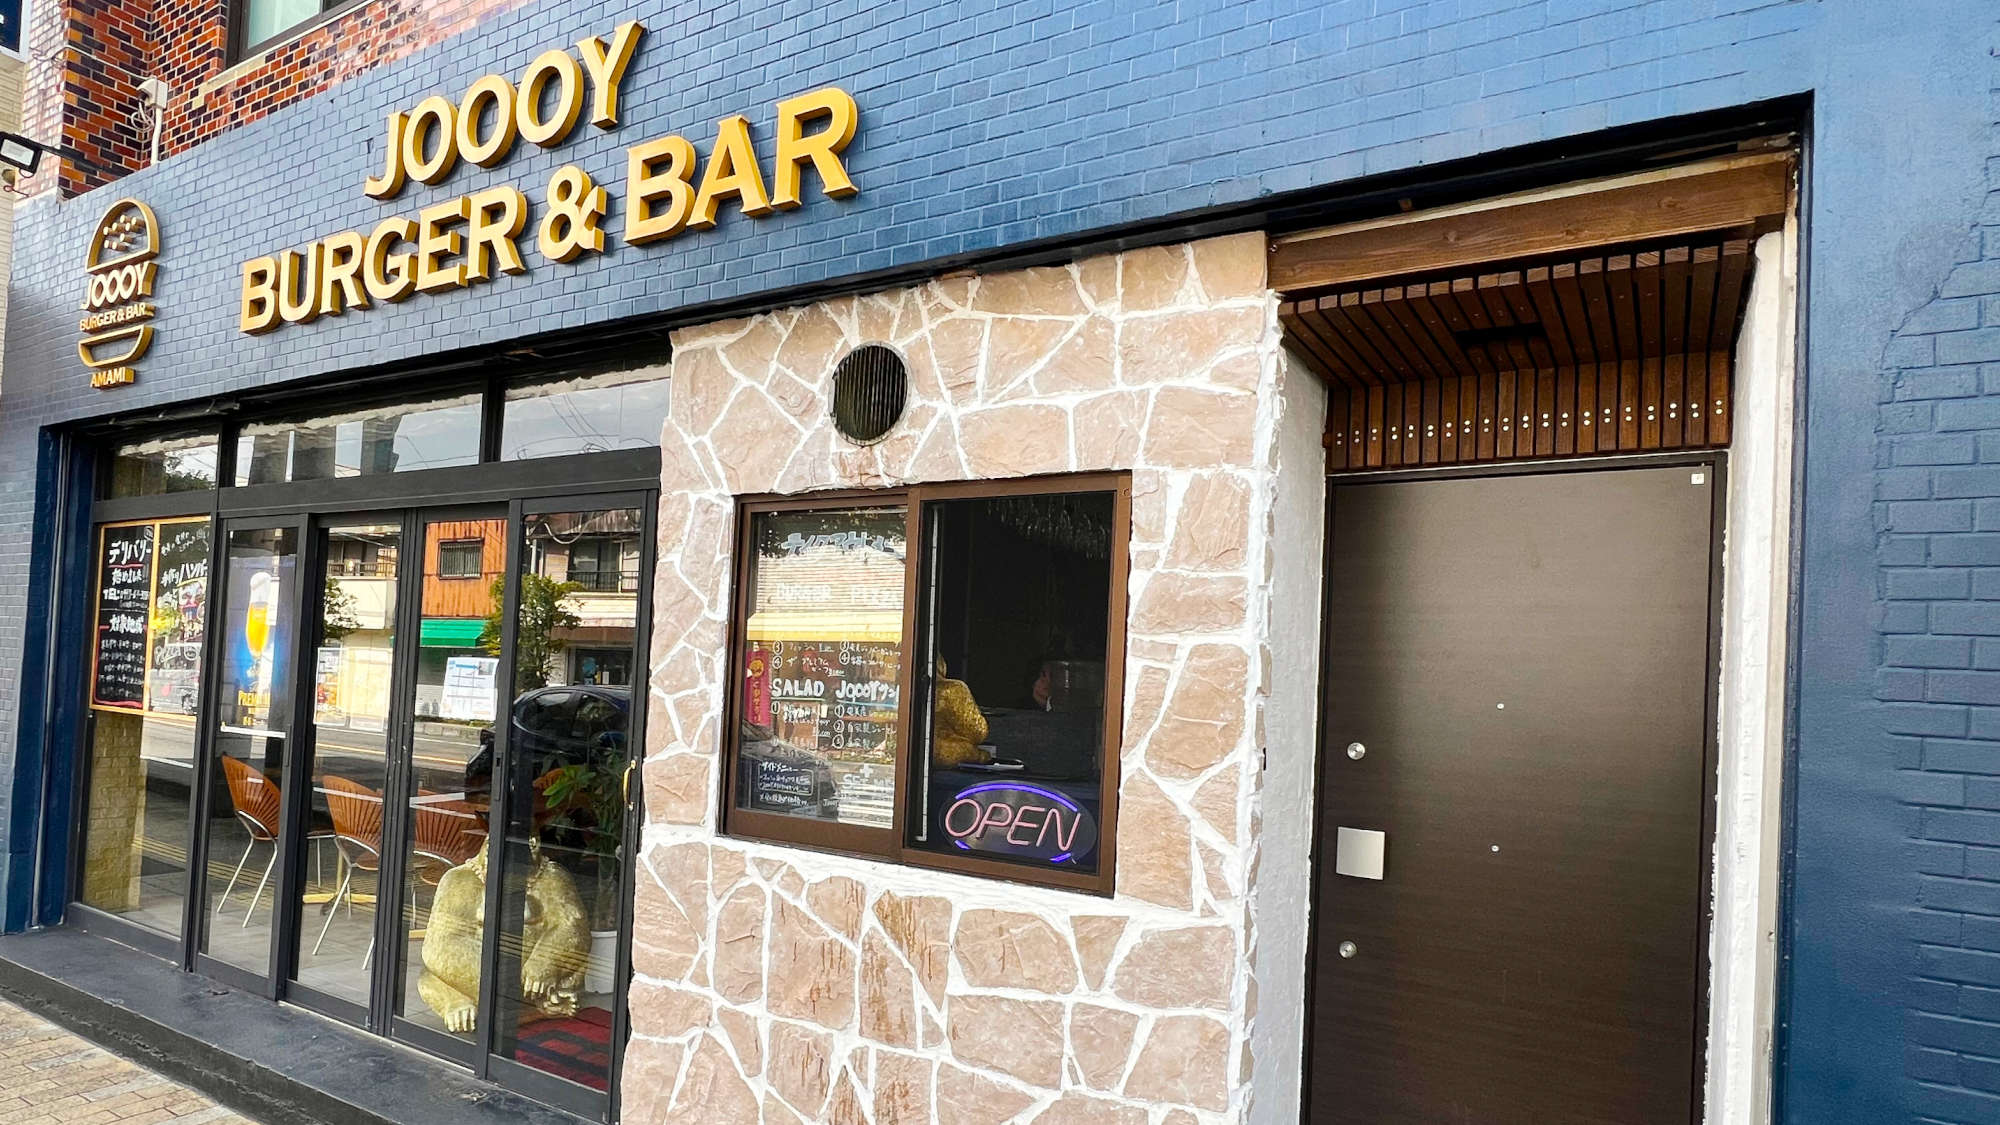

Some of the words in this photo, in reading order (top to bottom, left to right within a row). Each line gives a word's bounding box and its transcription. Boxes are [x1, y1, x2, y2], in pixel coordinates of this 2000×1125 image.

[365, 19, 647, 201] JOOOY
[239, 186, 527, 335] BURGER
[538, 165, 607, 263] &
[624, 87, 859, 246] BAR
[80, 261, 158, 311] JOOOY
[90, 366, 135, 389] AMAMI
[109, 540, 152, 565] デリバリー
[771, 678, 825, 697] SALAD
[945, 798, 1081, 851] OPEN
